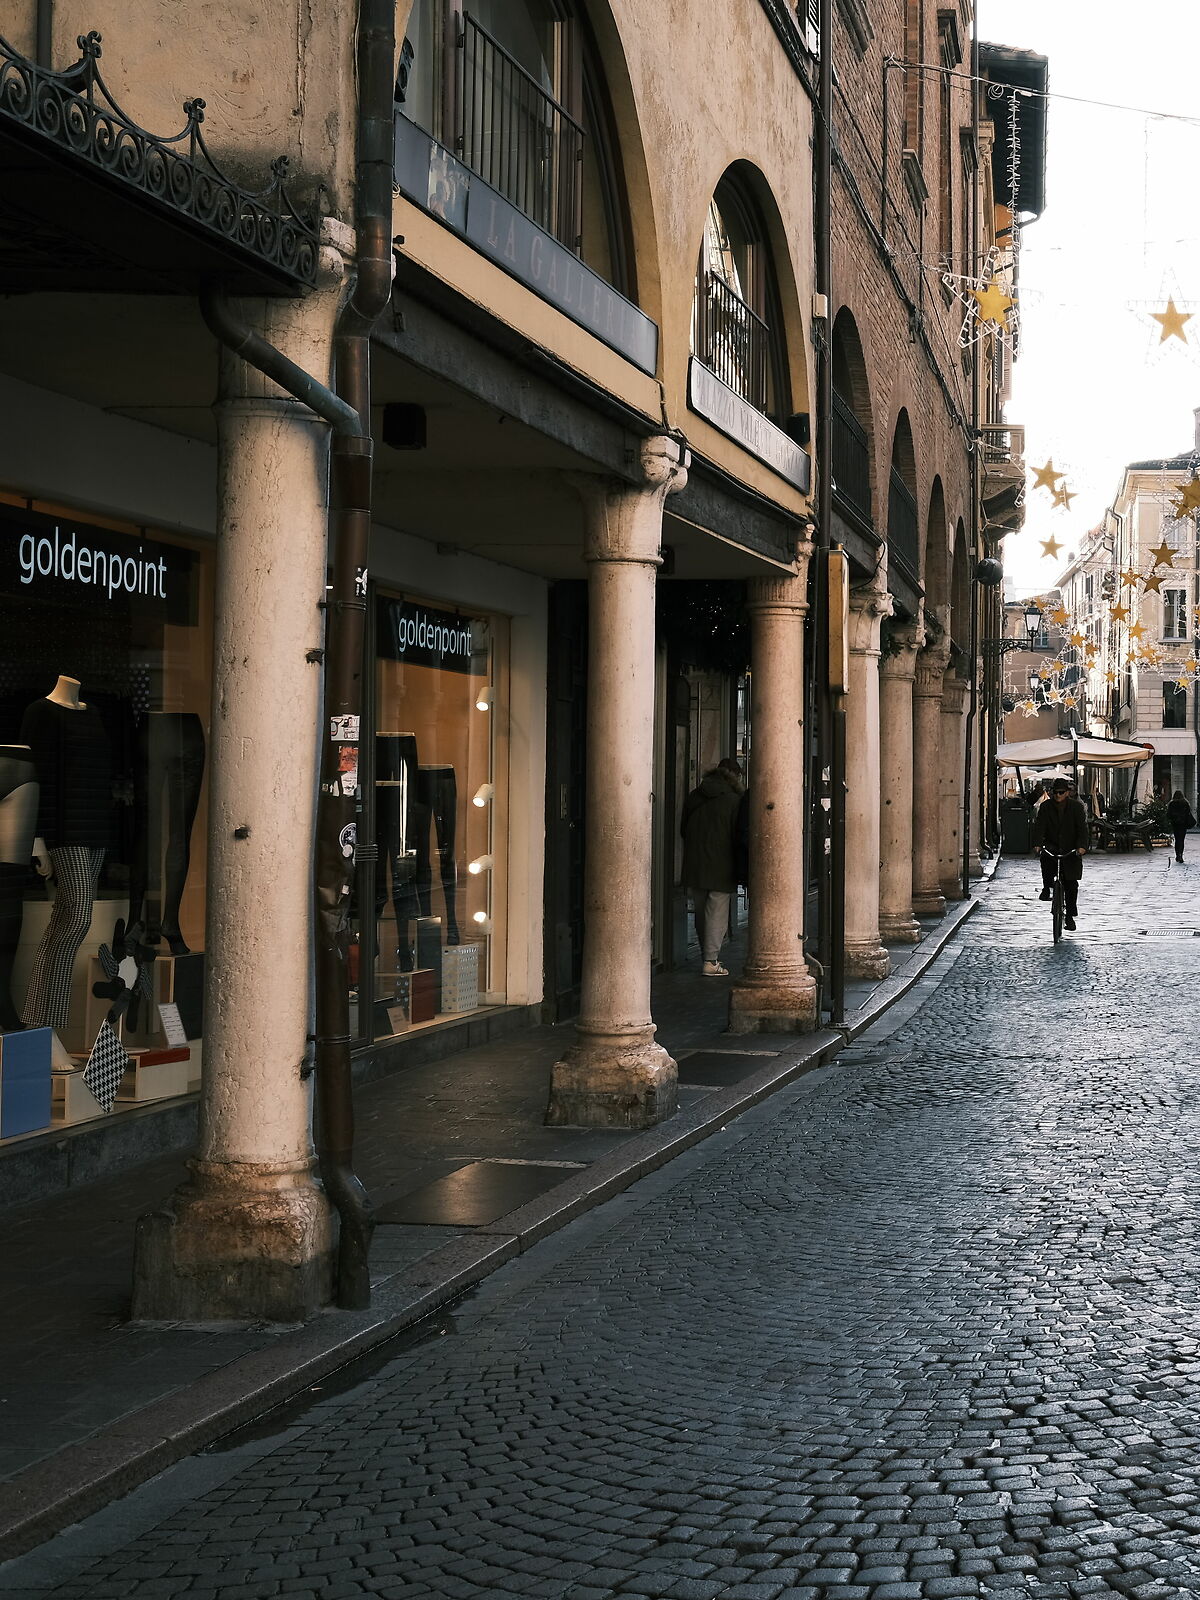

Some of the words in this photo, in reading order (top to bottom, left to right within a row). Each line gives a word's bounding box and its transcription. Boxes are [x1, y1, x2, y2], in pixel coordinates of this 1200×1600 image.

[487, 199, 517, 263] LA
[530, 235, 640, 352] GALLERIA
[19, 526, 167, 599] goldenpoint
[399, 611, 471, 660] goldenpoint
